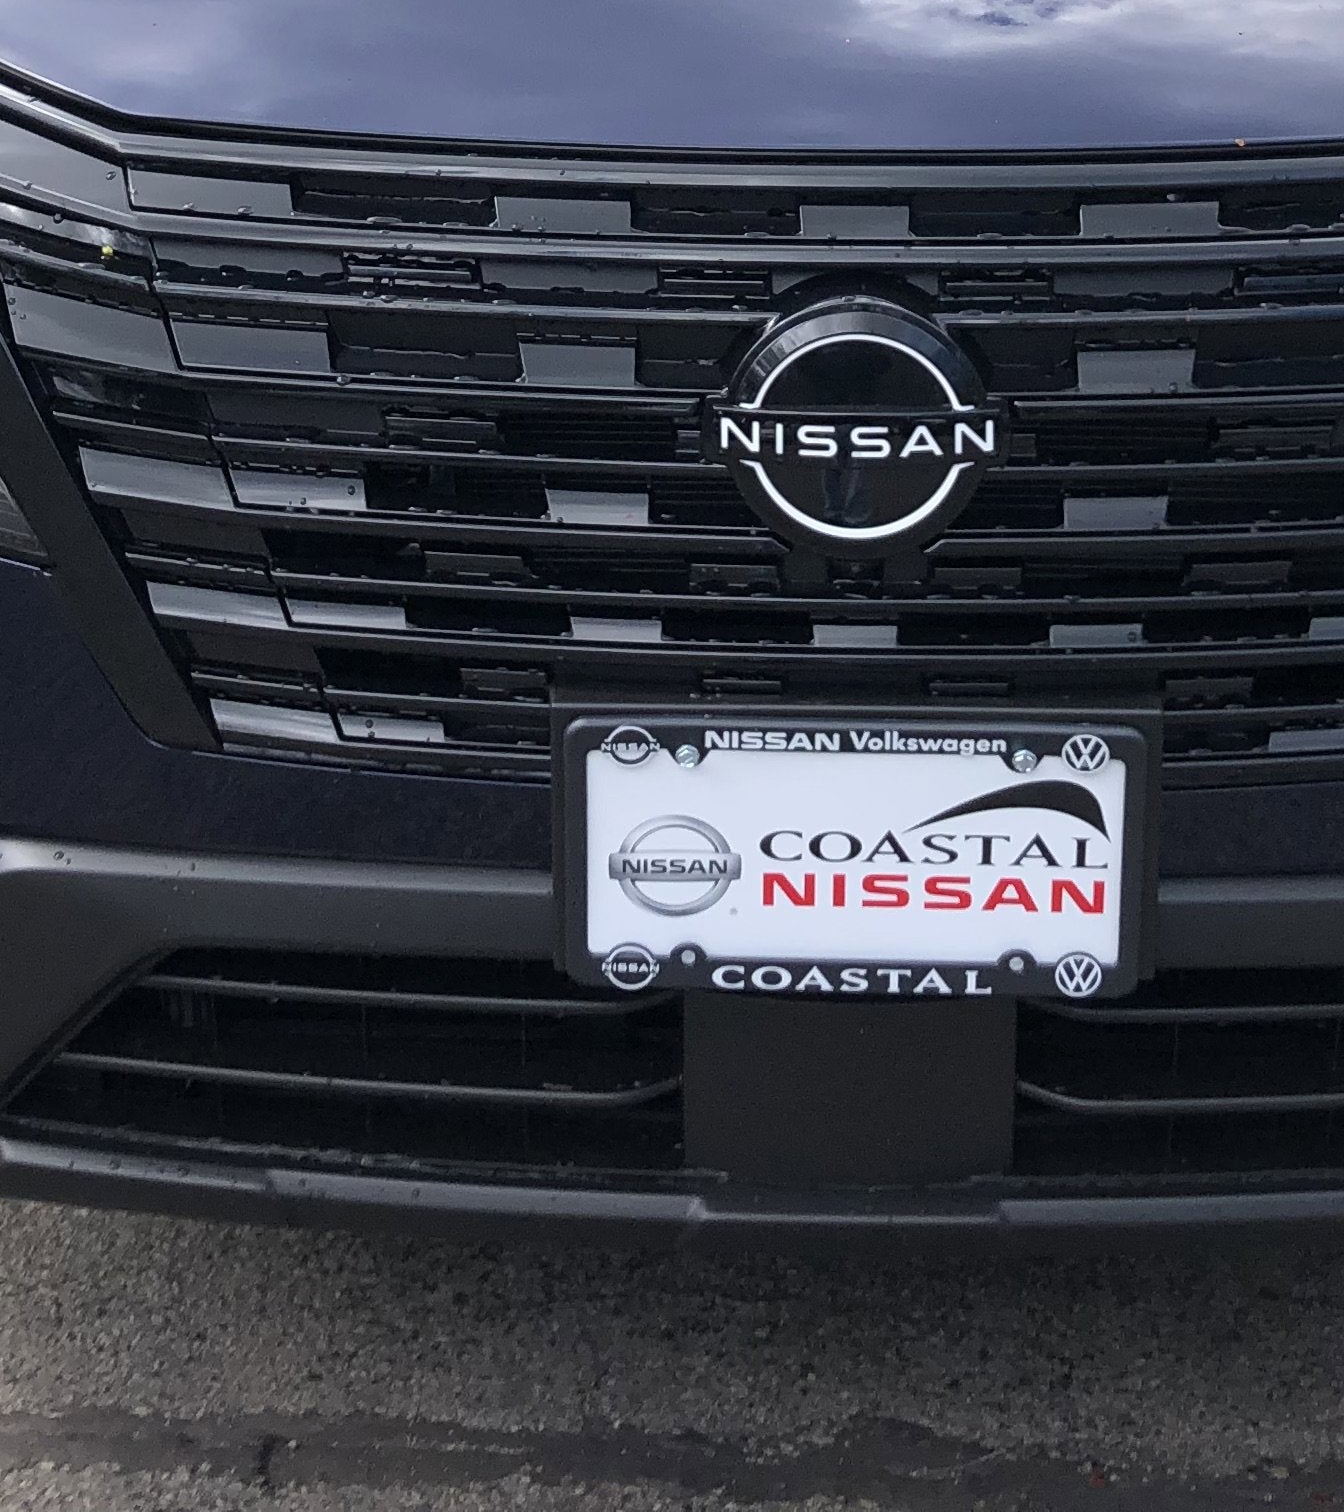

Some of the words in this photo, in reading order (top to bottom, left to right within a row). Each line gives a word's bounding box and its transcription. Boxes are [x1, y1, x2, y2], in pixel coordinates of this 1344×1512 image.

[719, 417, 996, 458] NISSAN
[704, 730, 840, 751] NISSAN
[850, 730, 1007, 756] Volkswagen
[621, 858, 728, 874] NISSAN
[759, 829, 1109, 870] COASTAL
[762, 872, 1105, 914] NISSAN
[711, 964, 992, 995] COASTAL
